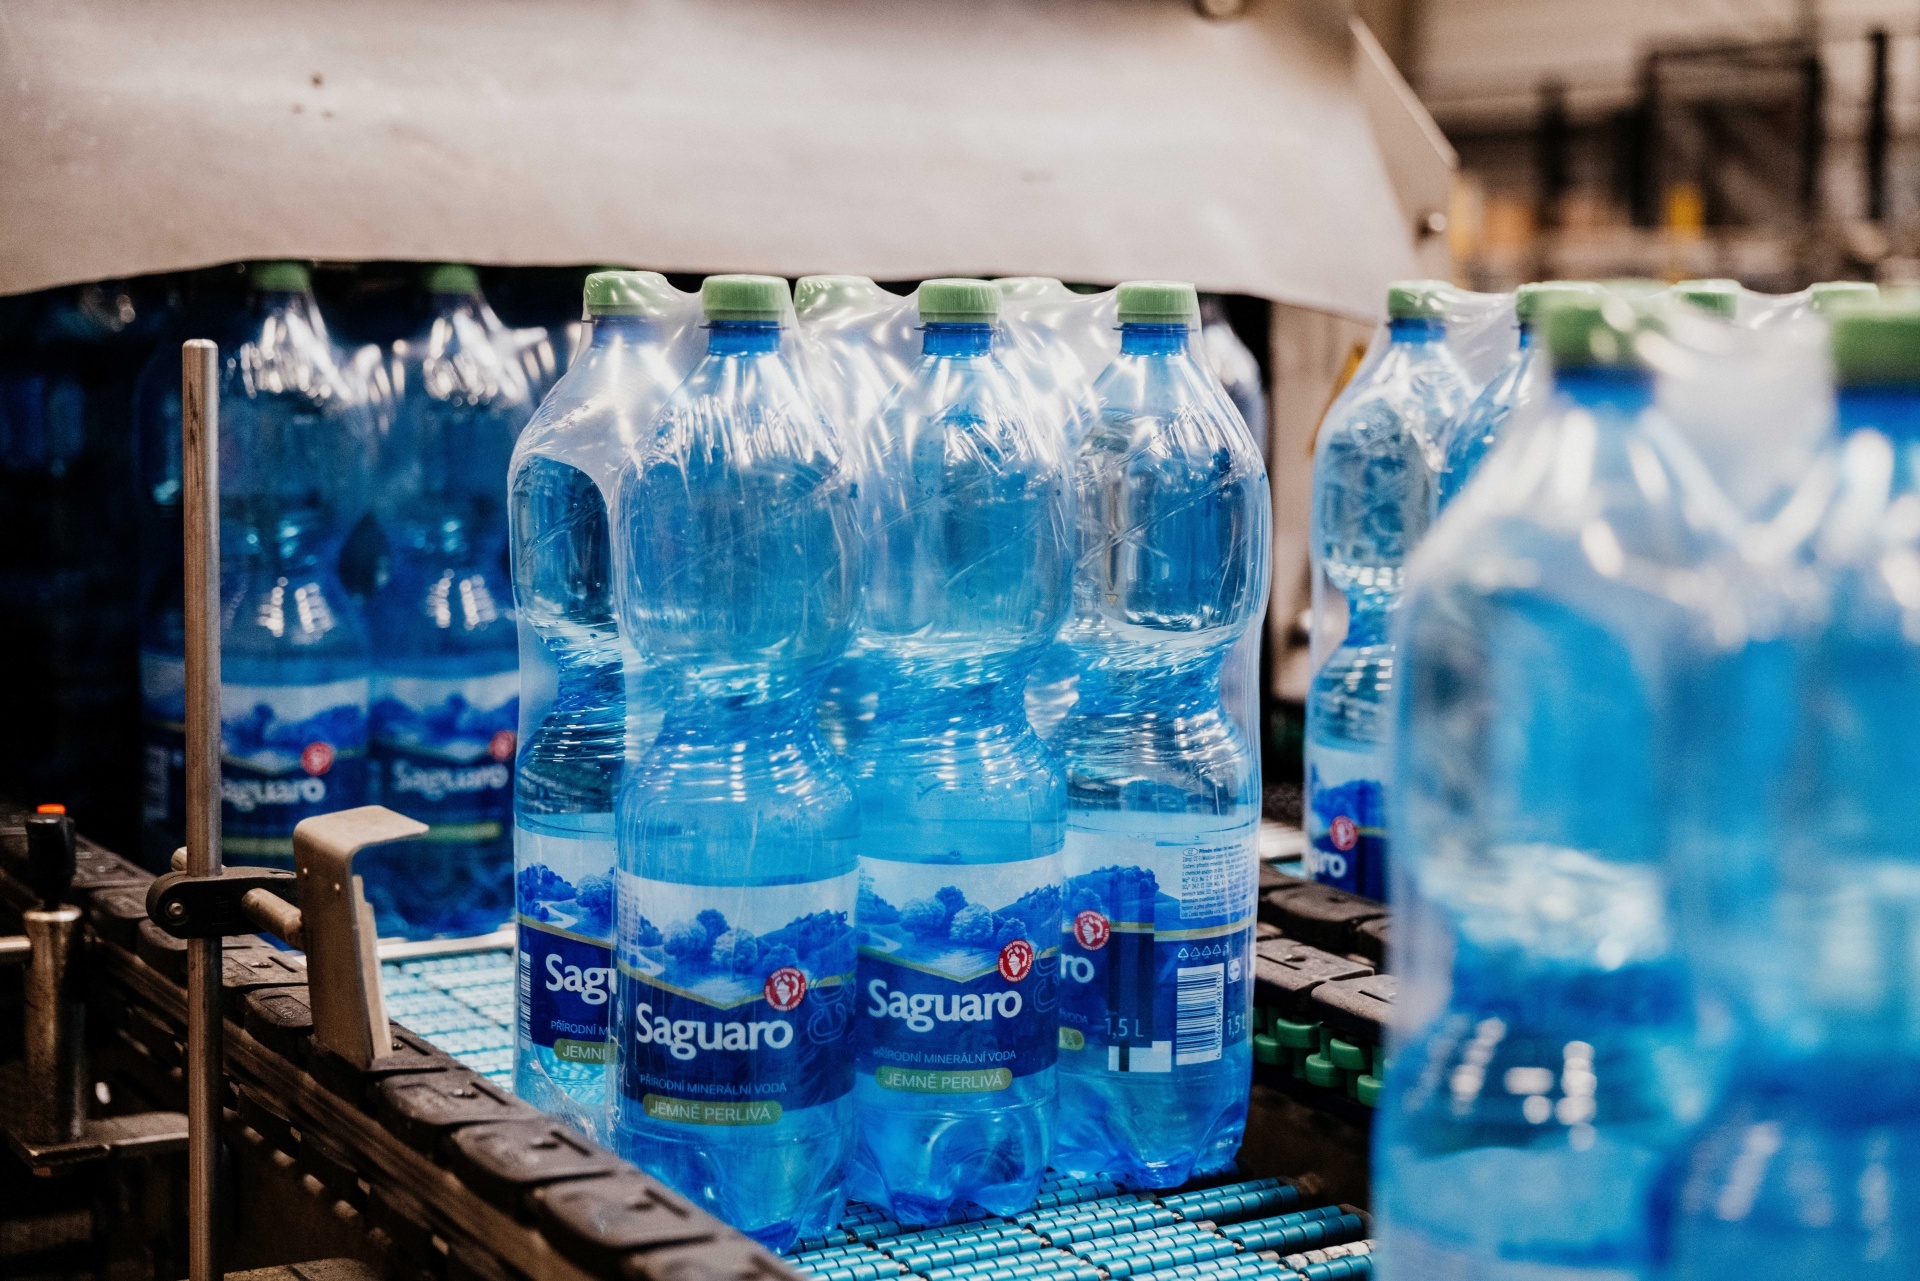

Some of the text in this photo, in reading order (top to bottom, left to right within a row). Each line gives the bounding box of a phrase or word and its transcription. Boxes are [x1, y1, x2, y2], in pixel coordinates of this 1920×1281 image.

[868, 978, 1023, 1033] Saguaro
[550, 1020, 597, 1036] PŘÍRODNÍ
[636, 1002, 794, 1061] Saguaro
[1104, 1017, 1145, 1039] 1,5 L
[562, 1044, 607, 1061] JEMN
[924, 1050, 986, 1065] MINERÁLNÍ
[987, 1050, 1017, 1063] VODA
[640, 1073, 787, 1096] PŘÍRODNÍ MINERÁLNÍ VODA
[885, 1071, 1003, 1089] JEMNĚ PERLIVÁ
[650, 1099, 772, 1122] JEMNĚ PERLIVÁ
